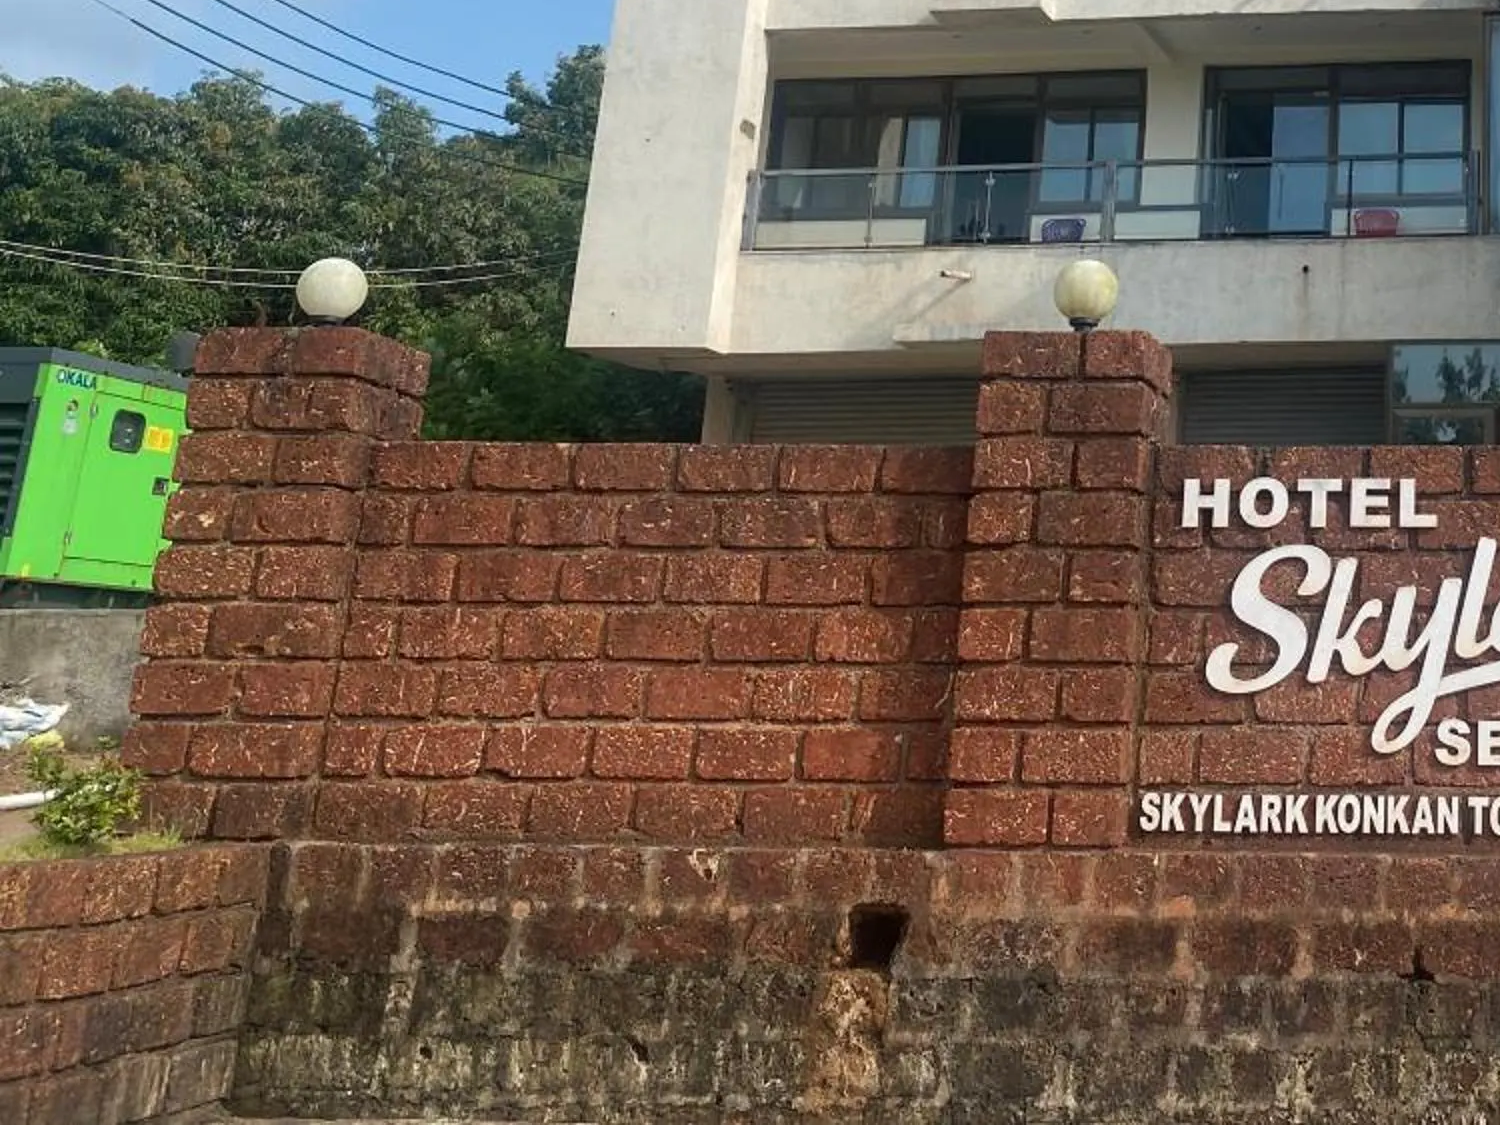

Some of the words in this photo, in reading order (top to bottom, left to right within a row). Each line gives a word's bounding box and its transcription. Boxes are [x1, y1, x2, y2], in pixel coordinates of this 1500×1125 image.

[1180, 476, 1439, 529] HOTEL
[1138, 791, 1310, 834] SKYLARK
[1314, 792, 1461, 836] KONKAN
